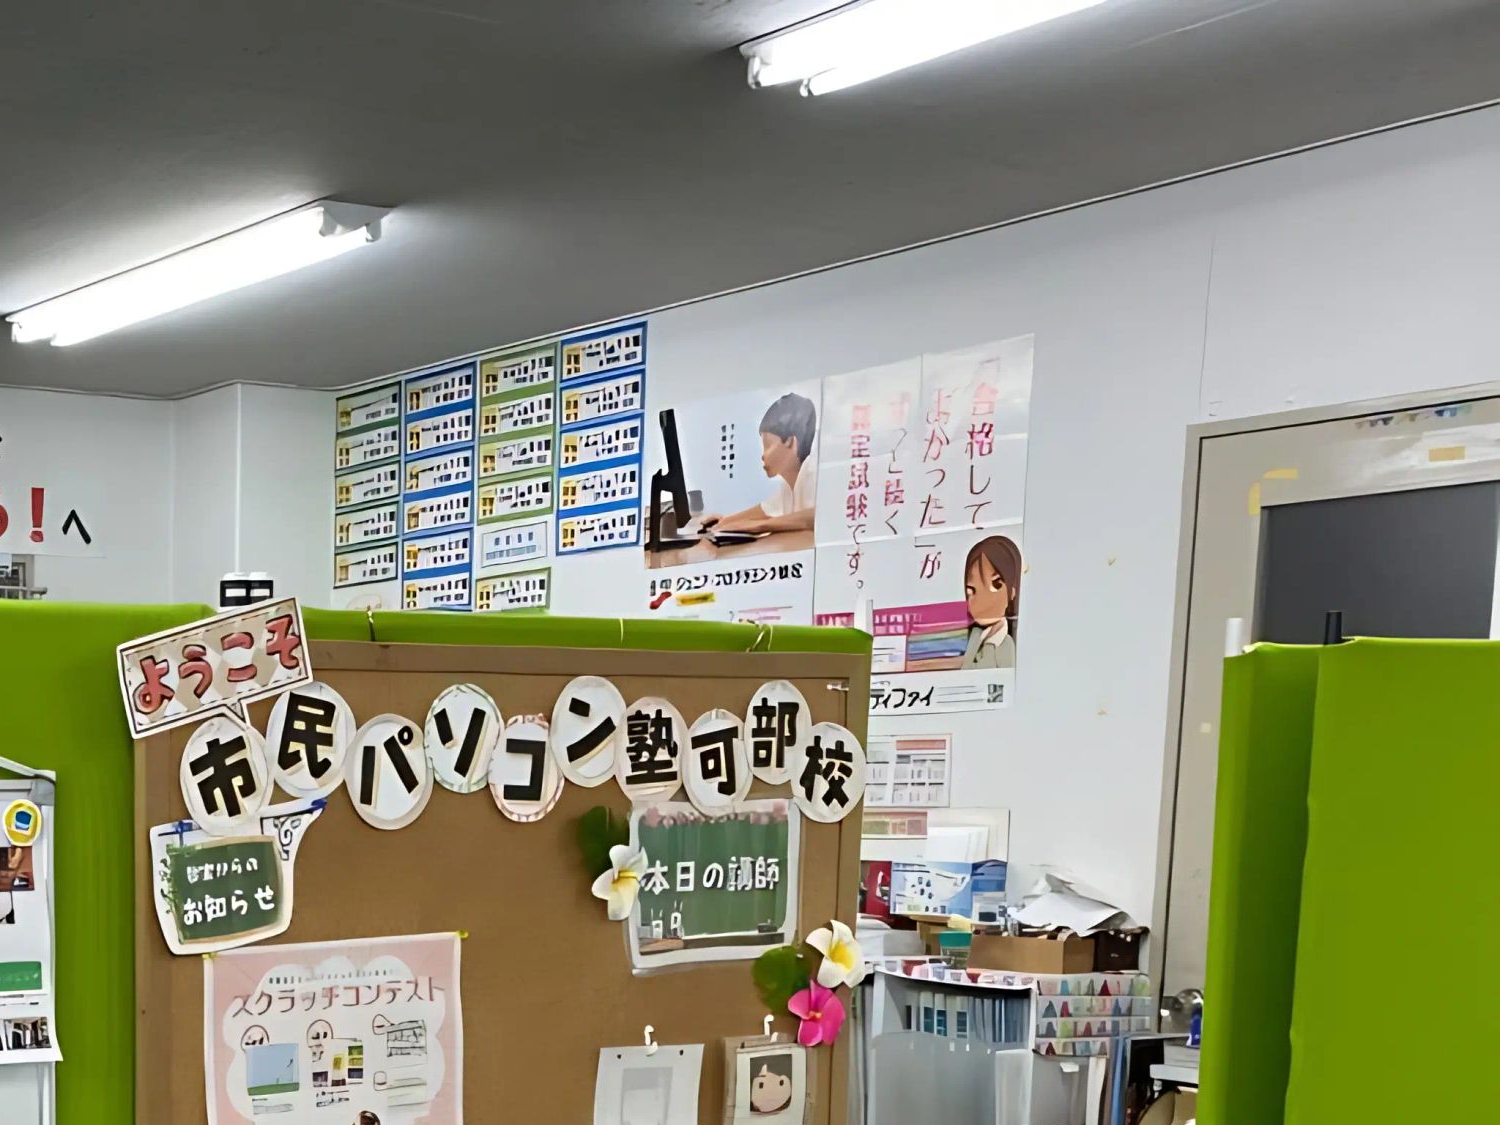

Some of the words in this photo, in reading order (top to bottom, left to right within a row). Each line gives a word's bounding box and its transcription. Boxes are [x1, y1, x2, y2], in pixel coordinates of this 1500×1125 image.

[133, 613, 301, 714] ようこそ
[189, 690, 854, 818] 市民パソコン塾可部校
[183, 884, 276, 926] お知らせ
[232, 975, 445, 1018] スクラッチコンテスト
